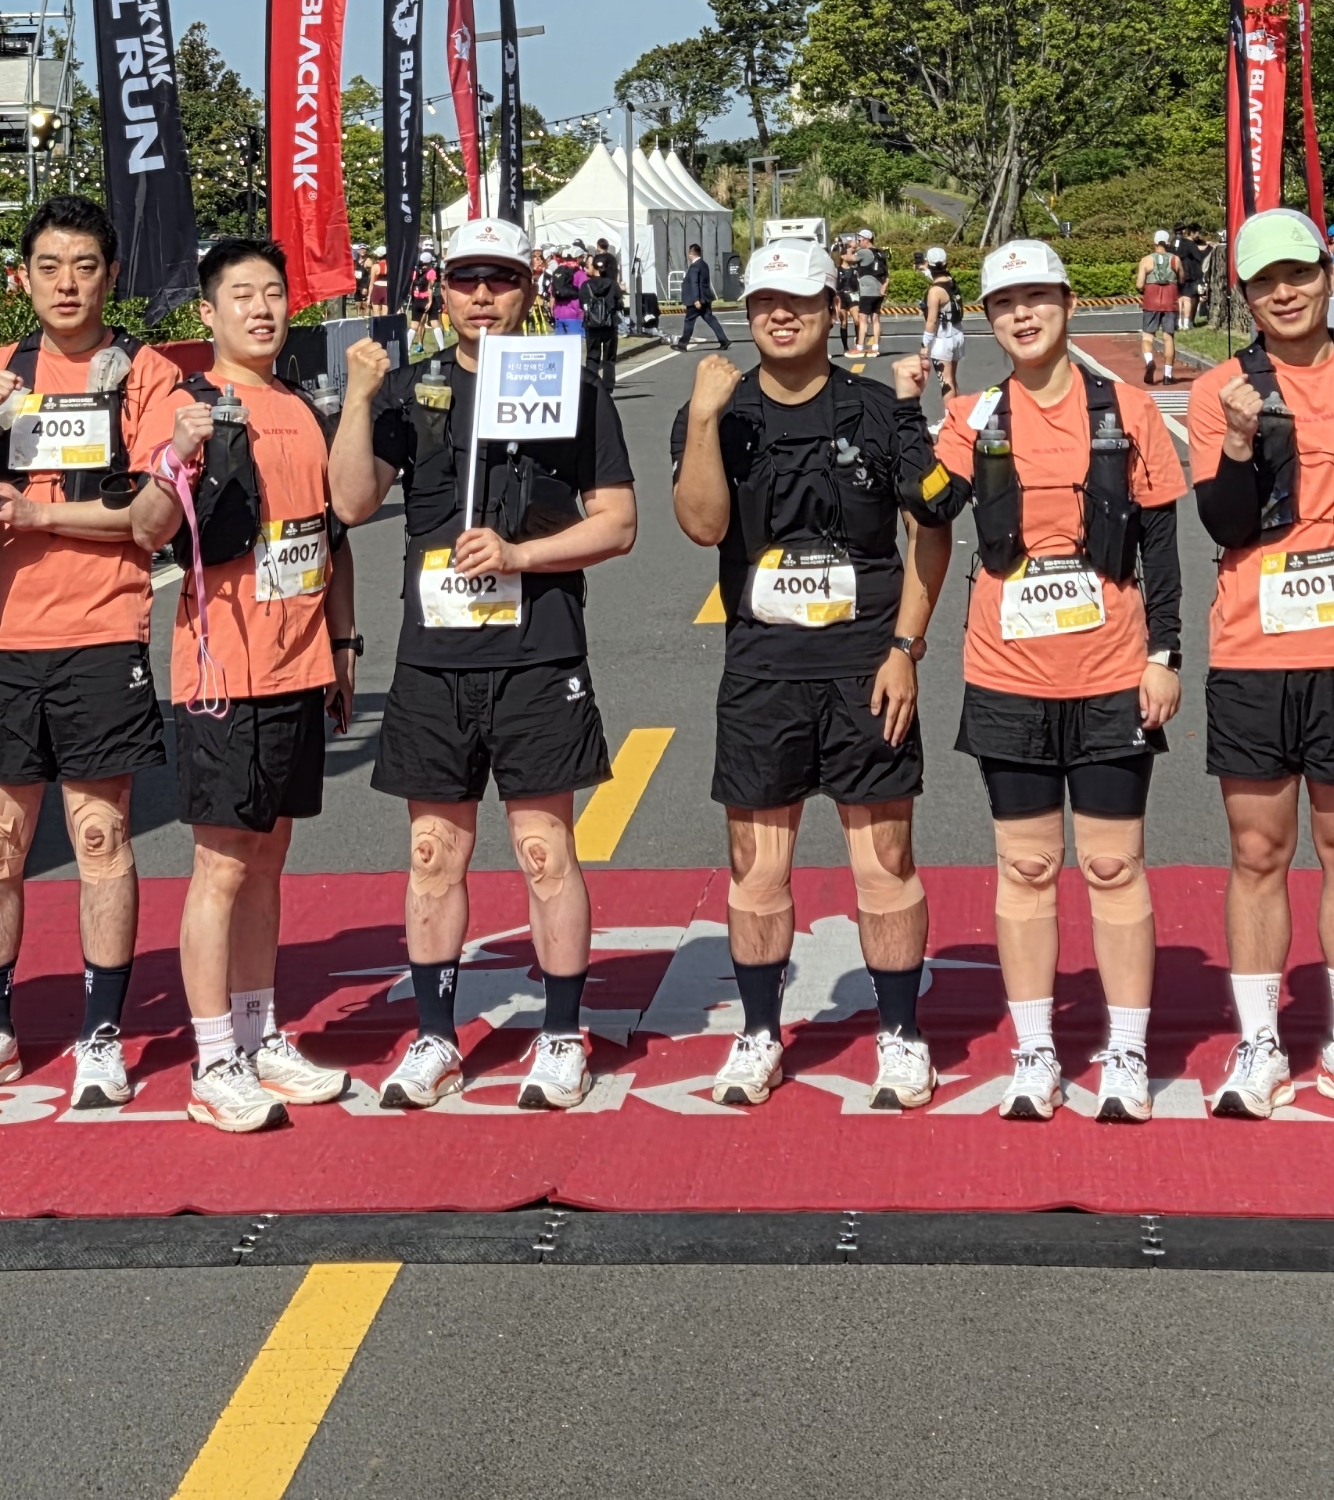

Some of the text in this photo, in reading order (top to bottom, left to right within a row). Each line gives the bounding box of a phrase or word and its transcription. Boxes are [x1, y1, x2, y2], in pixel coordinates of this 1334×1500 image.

[116, 37, 166, 175] RUN
[496, 401, 562, 425] BYN
[31, 418, 86, 438] 4003
[277, 541, 319, 566] 4007
[440, 575, 497, 594] 4002
[773, 576, 832, 596] 4004
[1020, 580, 1078, 604] 4008
[438, 967, 455, 998] BAC
